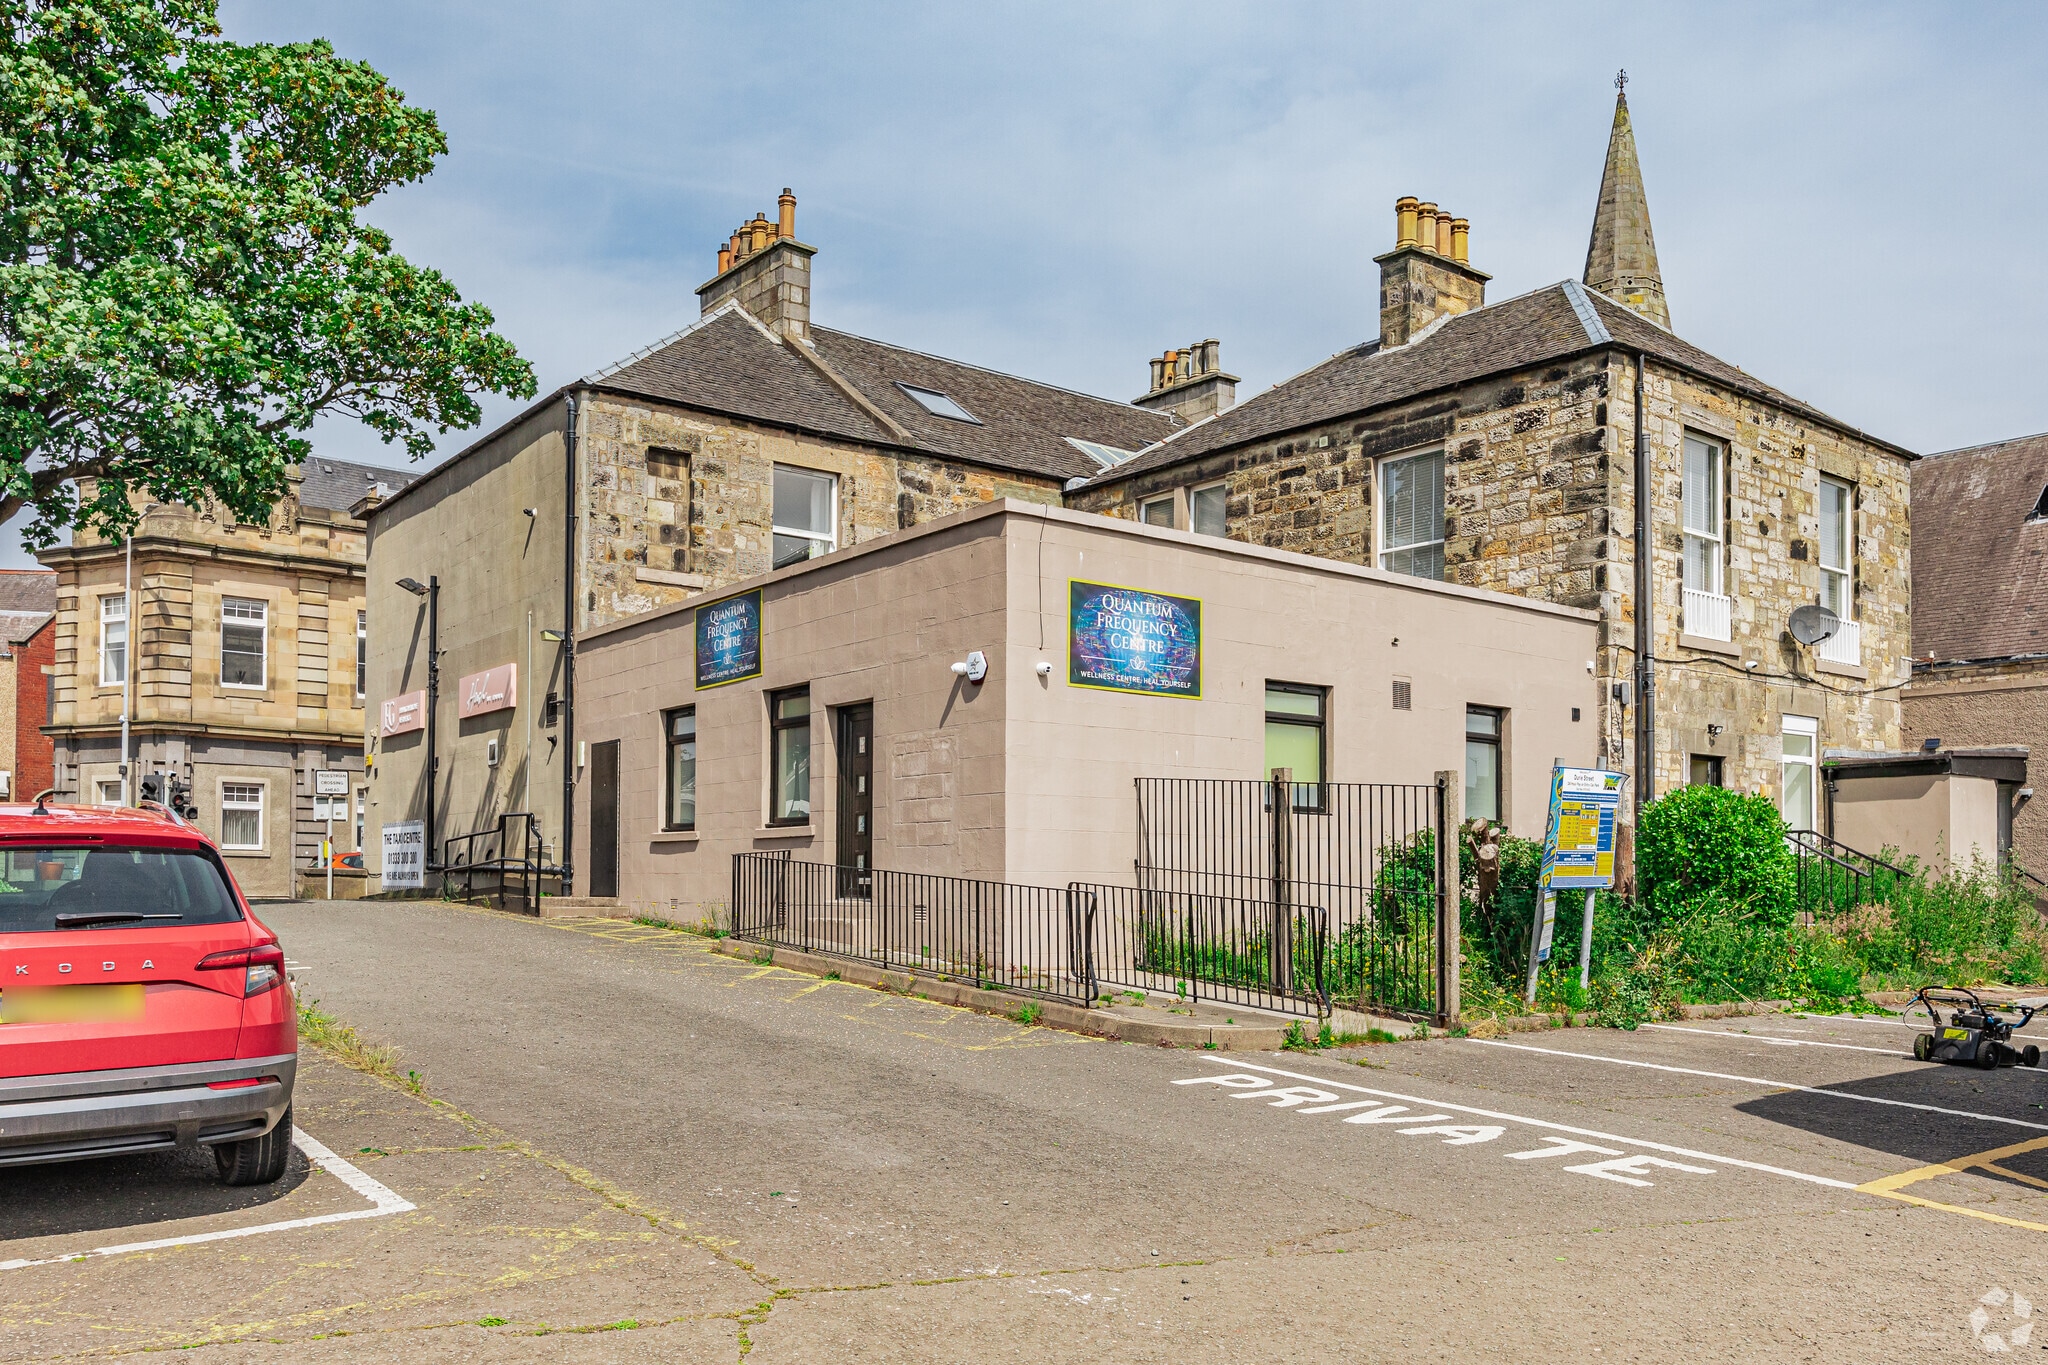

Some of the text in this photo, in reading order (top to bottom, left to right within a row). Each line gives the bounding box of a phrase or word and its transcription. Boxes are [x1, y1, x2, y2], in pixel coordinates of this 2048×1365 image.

[710, 603, 746, 625] QUANTUM
[1102, 594, 1172, 618] QUANTUM
[707, 617, 748, 638] FREQUENCY
[1097, 612, 1178, 637] FREQUENCY
[714, 635, 742, 652] CENTRE
[1110, 633, 1165, 654] CENTRE
[1080, 670, 1114, 680] WELLNESS
[1161, 680, 1192, 689] YOURSELF
[384, 834, 392, 845] THE
[403, 832, 421, 844] CENTRE
[1169, 1073, 1717, 1187] PRIVATE
